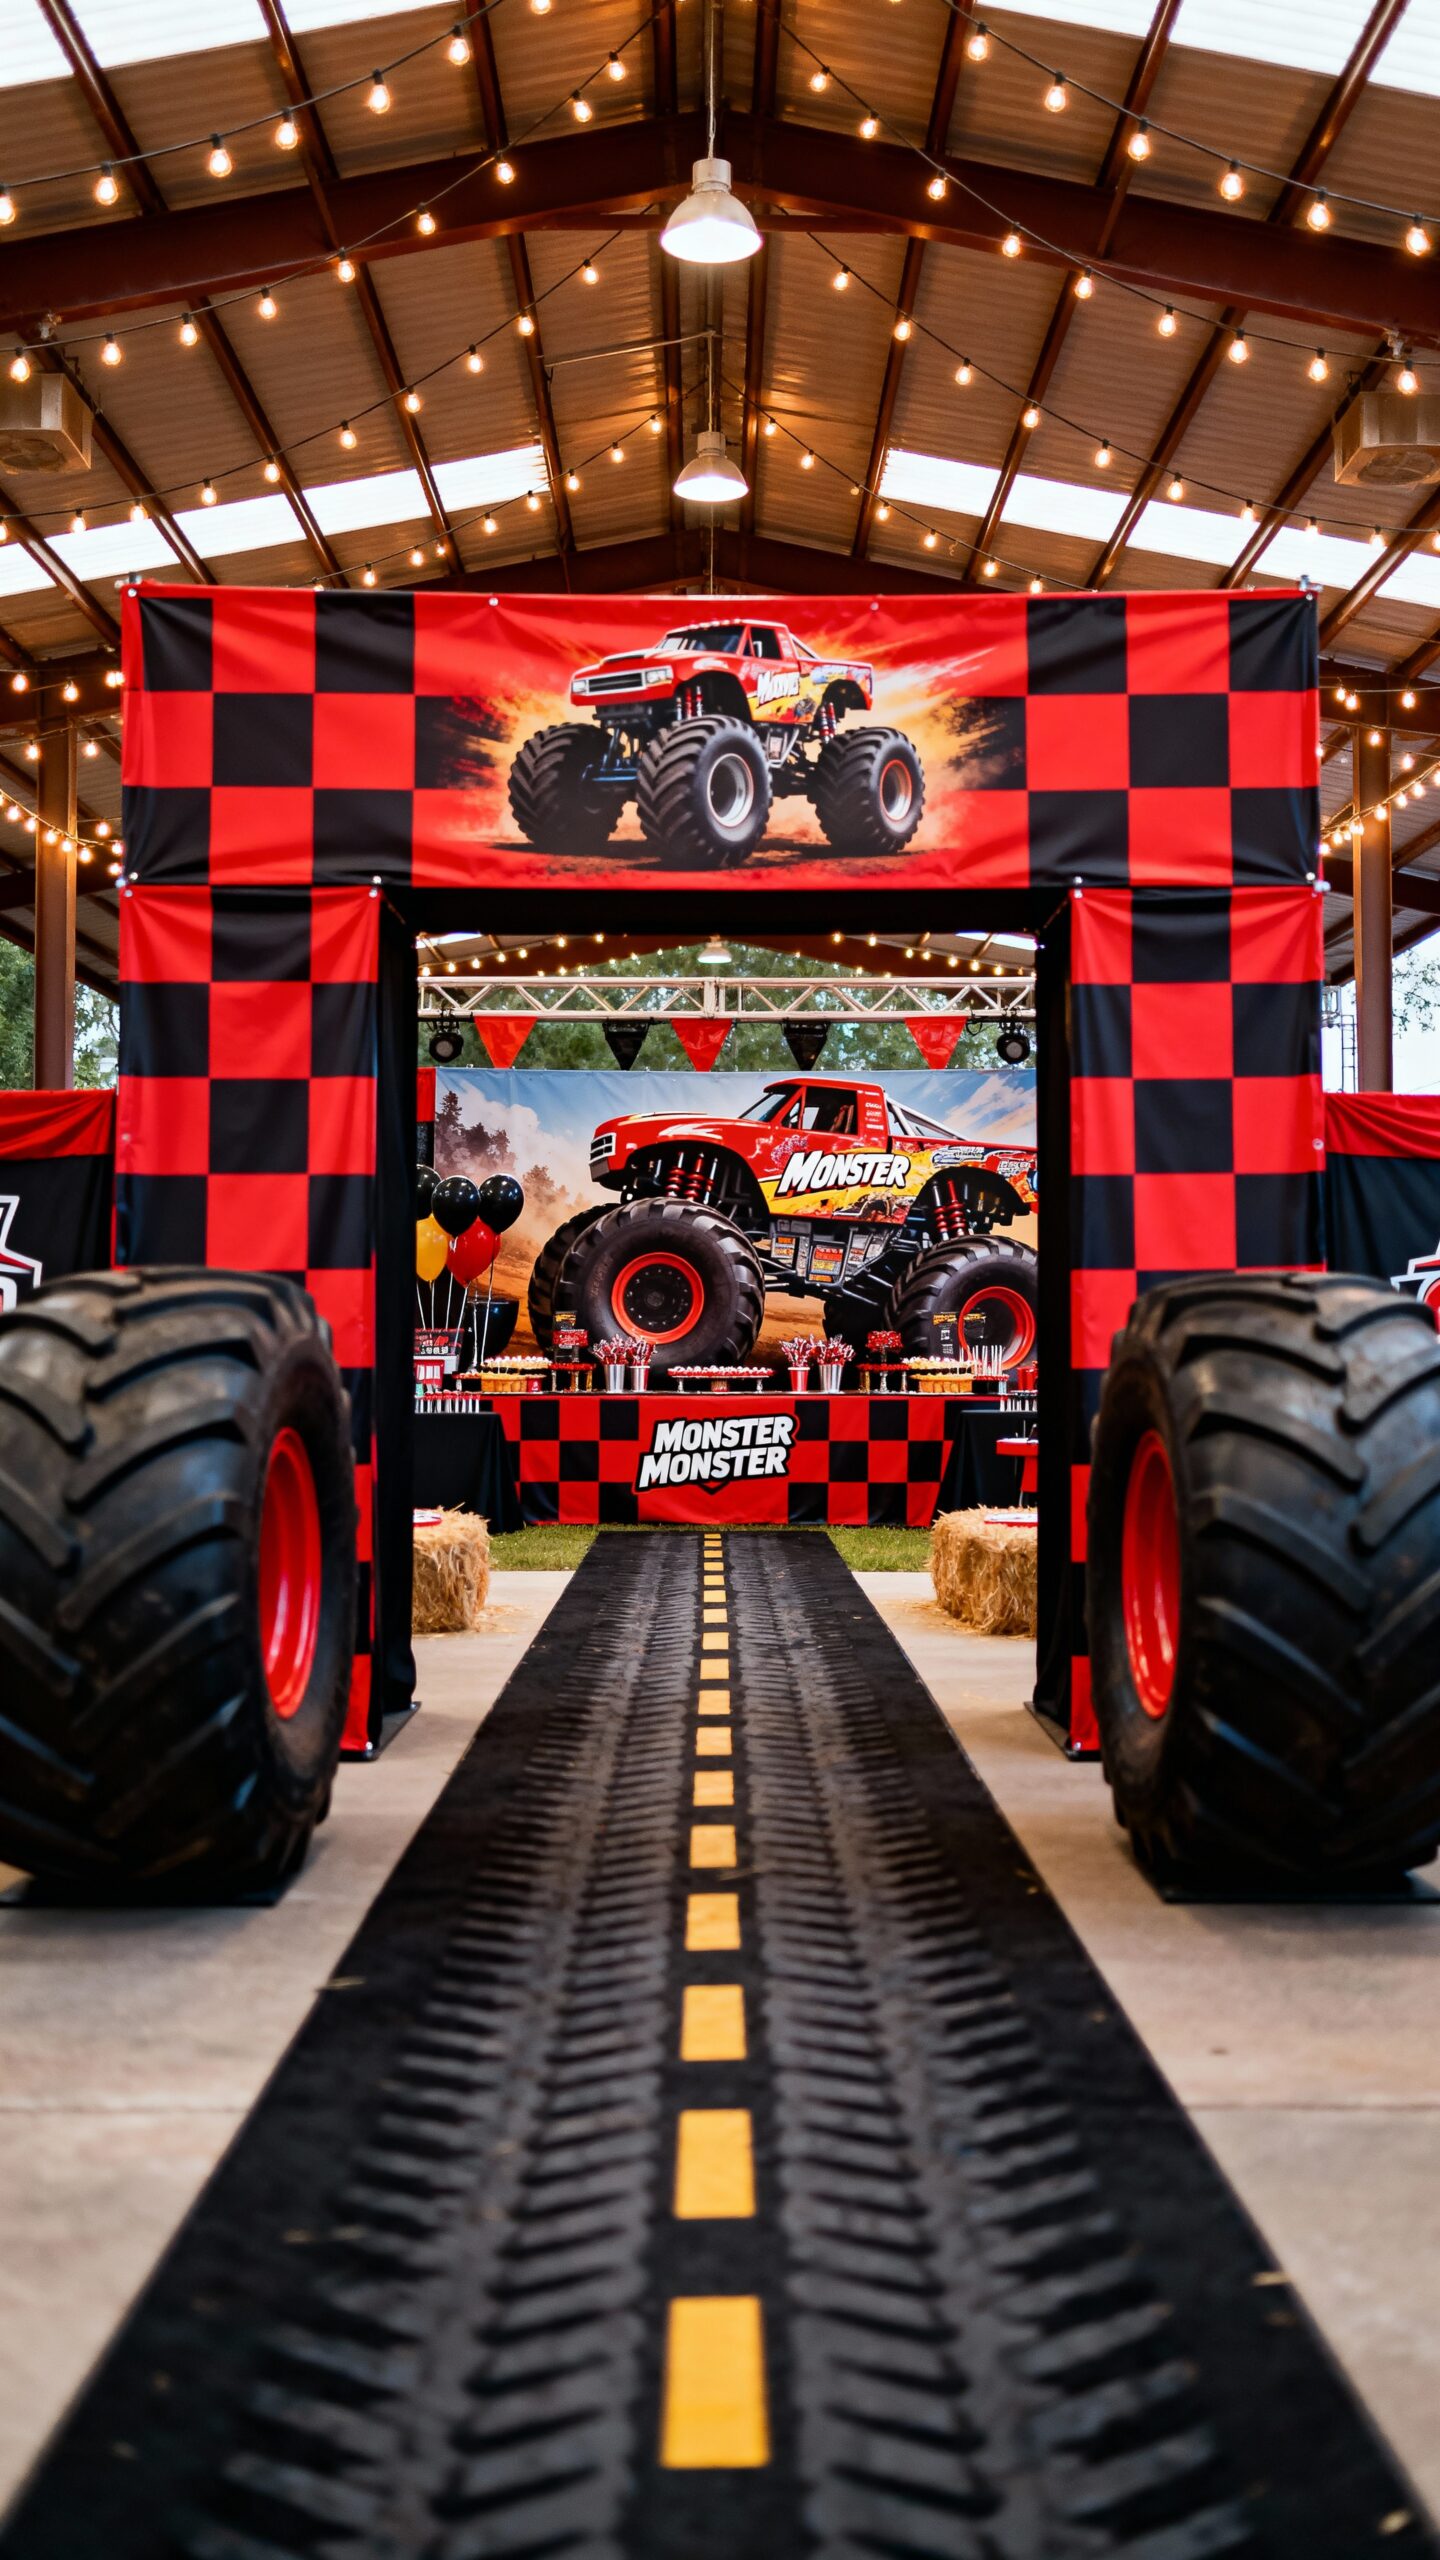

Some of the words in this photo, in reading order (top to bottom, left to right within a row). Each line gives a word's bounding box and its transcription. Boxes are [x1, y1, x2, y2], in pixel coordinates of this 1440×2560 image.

[777, 1150, 910, 1194] MONSTER
[654, 1416, 793, 1453] MONSTER
[639, 1446, 787, 1488] MONSTER
